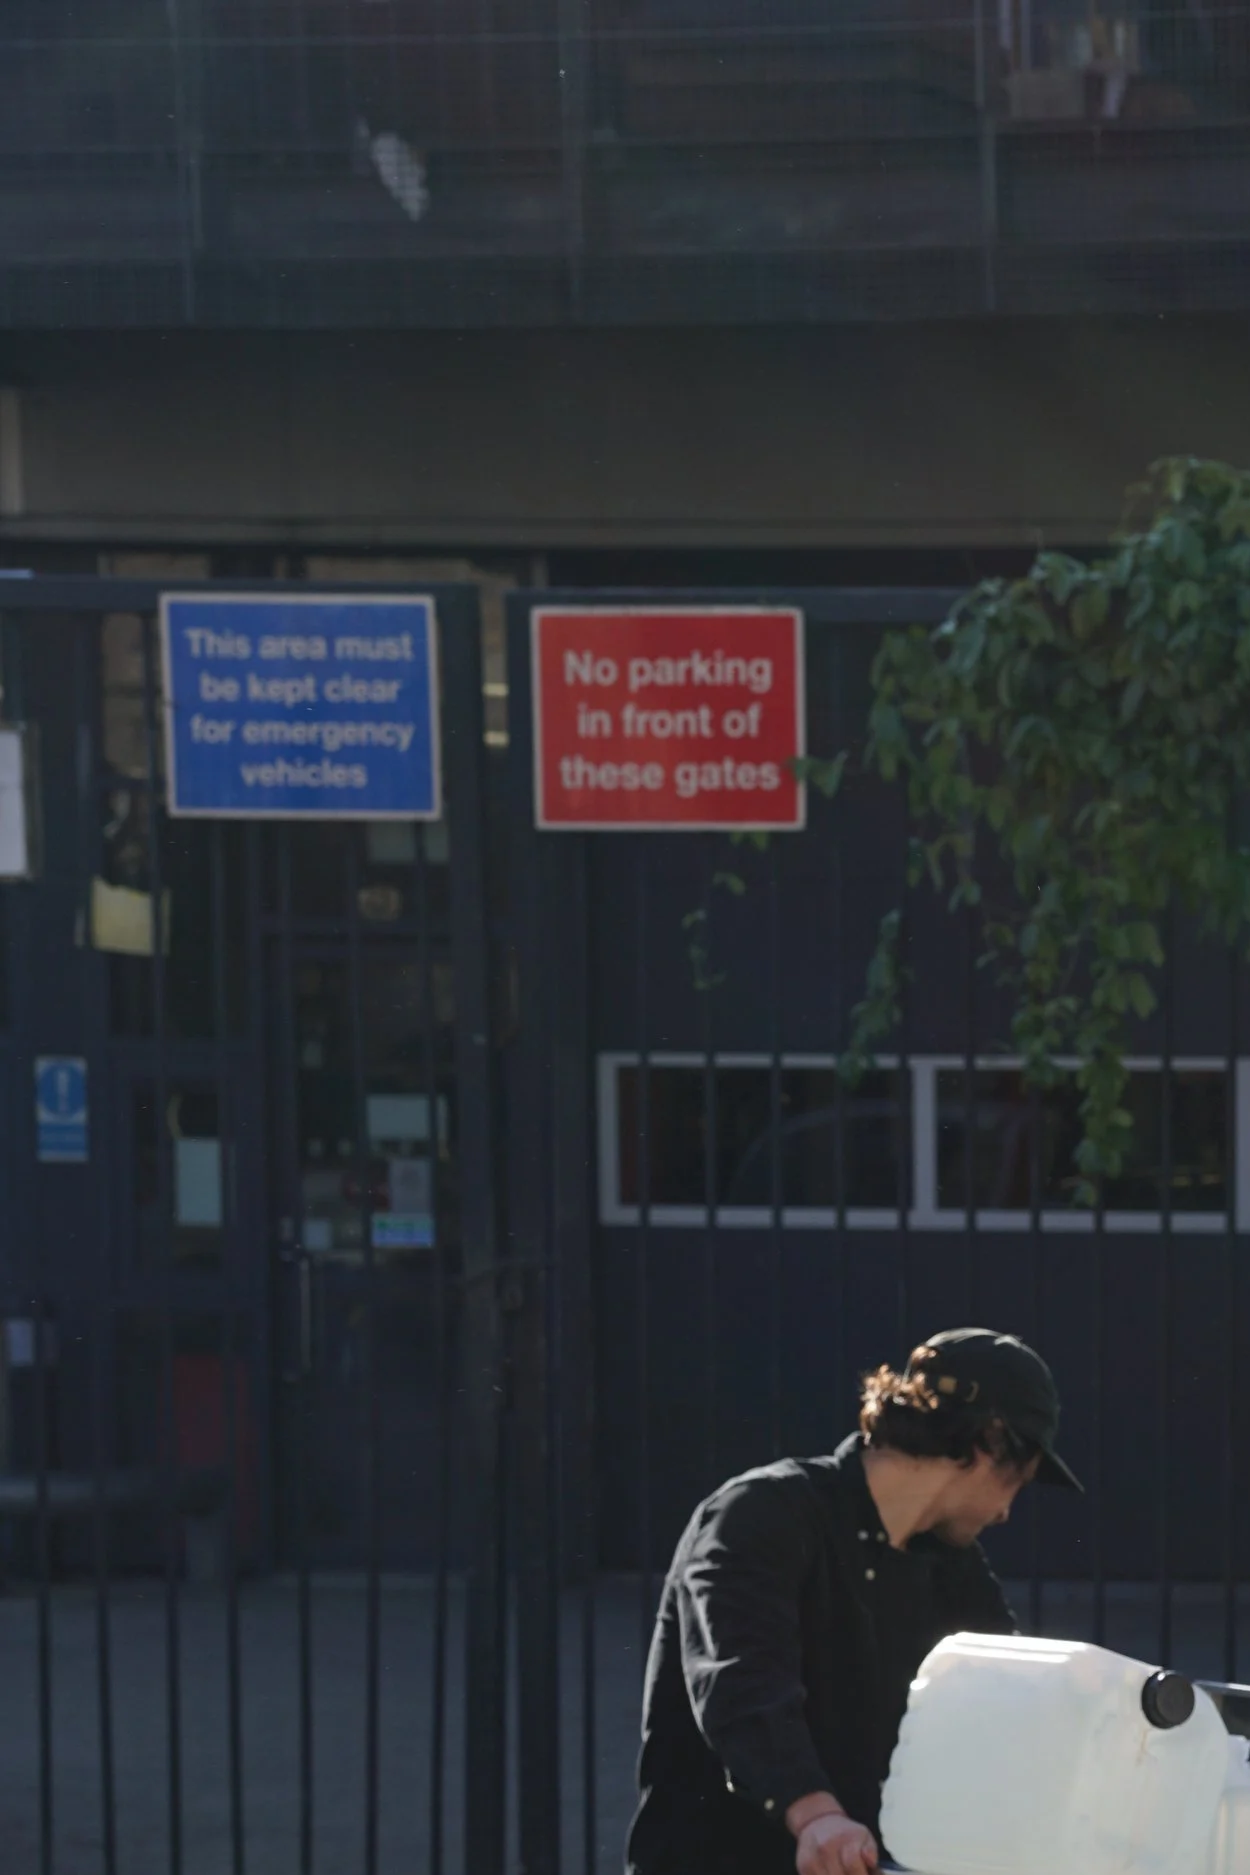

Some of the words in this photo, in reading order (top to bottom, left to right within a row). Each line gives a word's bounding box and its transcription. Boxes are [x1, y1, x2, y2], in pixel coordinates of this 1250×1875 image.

[184, 627, 251, 659] This
[259, 635, 327, 660] area
[335, 633, 414, 661] must
[200, 670, 240, 702] be
[247, 672, 316, 708] kept
[324, 672, 402, 703] clear
[564, 650, 617, 686] No
[628, 649, 772, 693] parking
[191, 713, 234, 743] for
[242, 720, 415, 752] emergency
[577, 702, 611, 738] in
[622, 702, 713, 738] front
[723, 702, 761, 738] of
[240, 757, 367, 789] vehicles
[560, 755, 663, 790] these
[675, 756, 780, 798] gates
